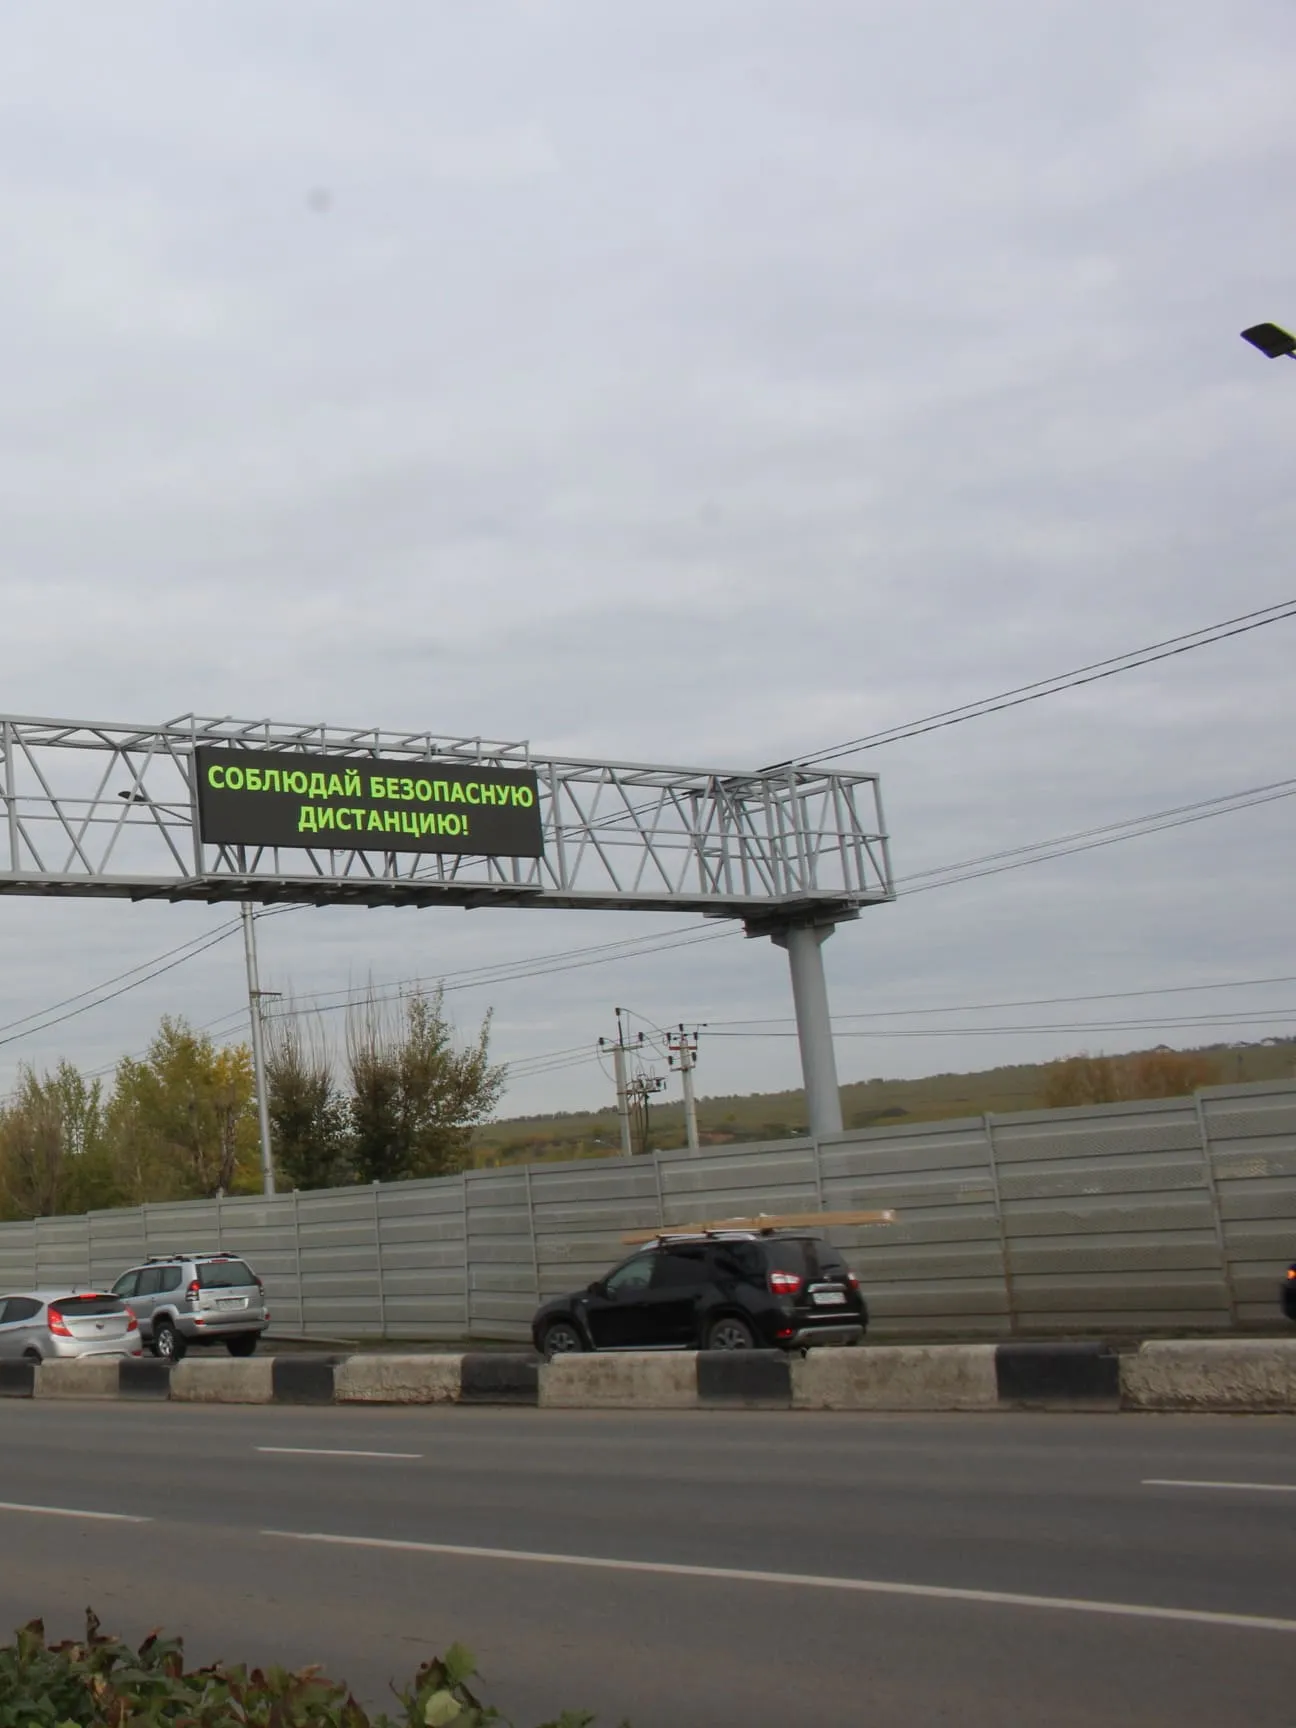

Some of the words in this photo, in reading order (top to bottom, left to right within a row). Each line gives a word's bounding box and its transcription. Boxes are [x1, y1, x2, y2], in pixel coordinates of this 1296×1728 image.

[207, 764, 362, 800] СОБЛЮДАЙ
[369, 776, 534, 808] БЕЗОПАСНУЮ
[297, 805, 470, 838] ДИСТАНЦИЮ!
